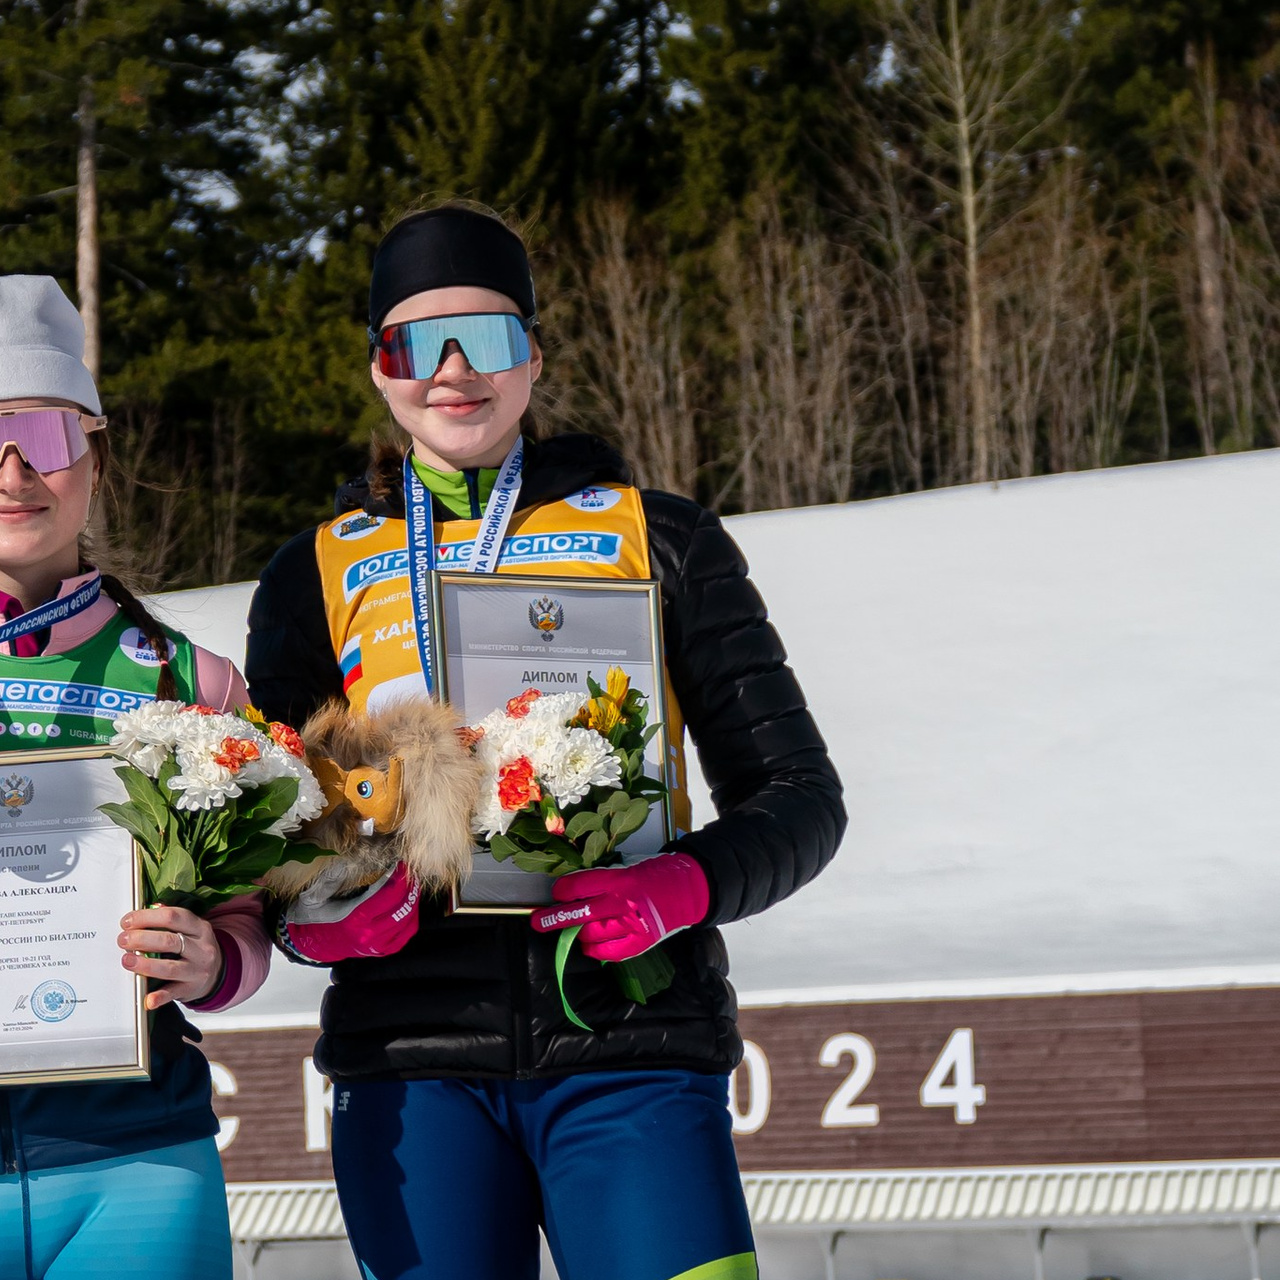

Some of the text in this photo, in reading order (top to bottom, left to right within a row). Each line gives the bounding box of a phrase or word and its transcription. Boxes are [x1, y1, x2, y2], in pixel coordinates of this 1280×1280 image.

[479, 486, 511, 556] РОССИЙСКОЙ
[521, 670, 578, 684] ДИПЛОМ
[1, 863, 40, 873] степени
[10, 885, 78, 897] АЛЕКСАНДРА
[34, 934, 48, 943] ПО
[49, 931, 97, 942] БИАТЛОНУ
